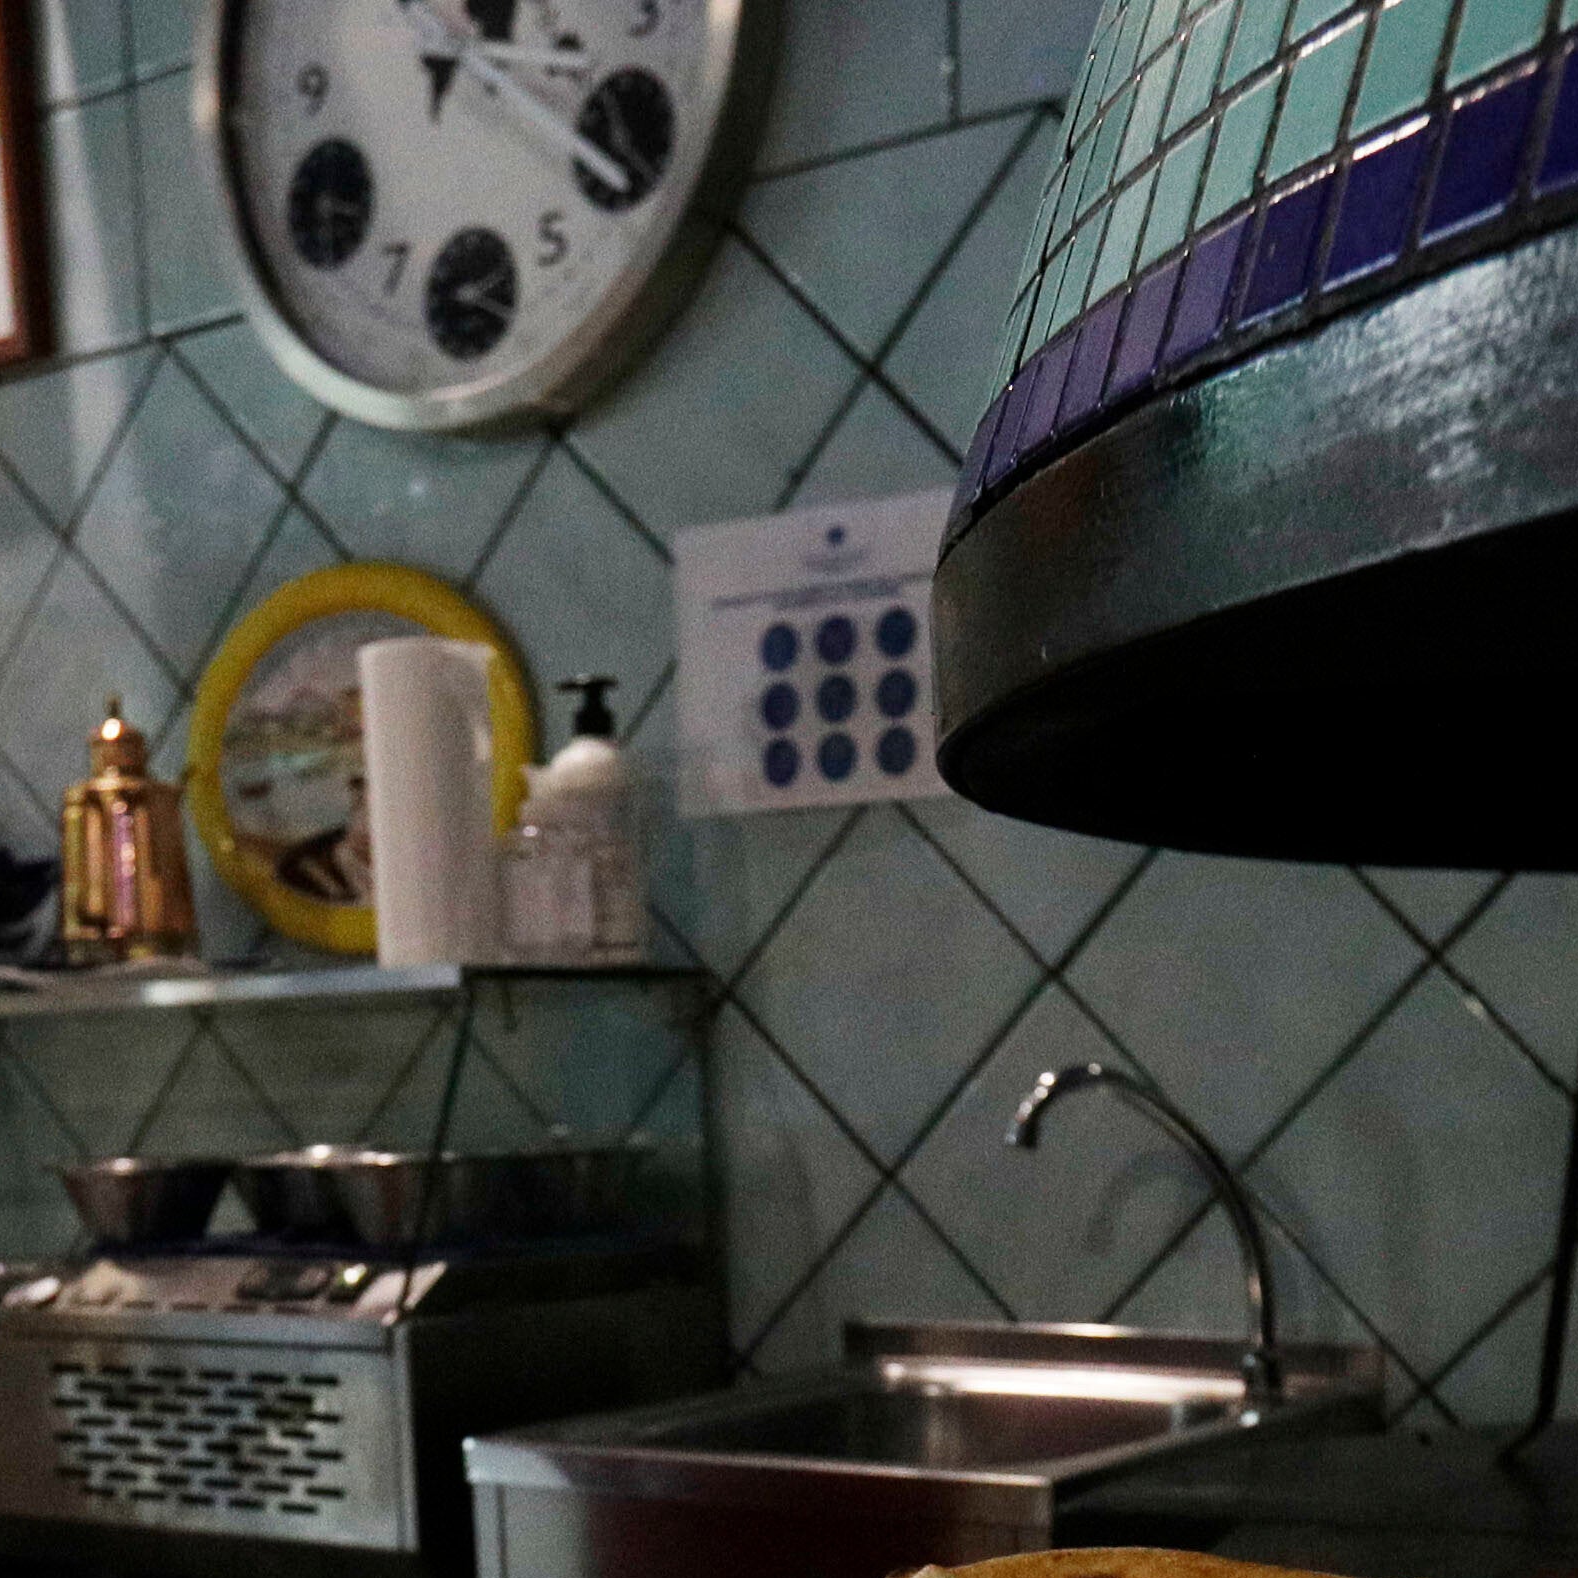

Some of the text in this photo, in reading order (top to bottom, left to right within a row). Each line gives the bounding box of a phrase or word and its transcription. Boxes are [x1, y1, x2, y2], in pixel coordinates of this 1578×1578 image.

[297, 62, 330, 117] 9
[537, 210, 570, 268] 5
[378, 241, 410, 297] 7
